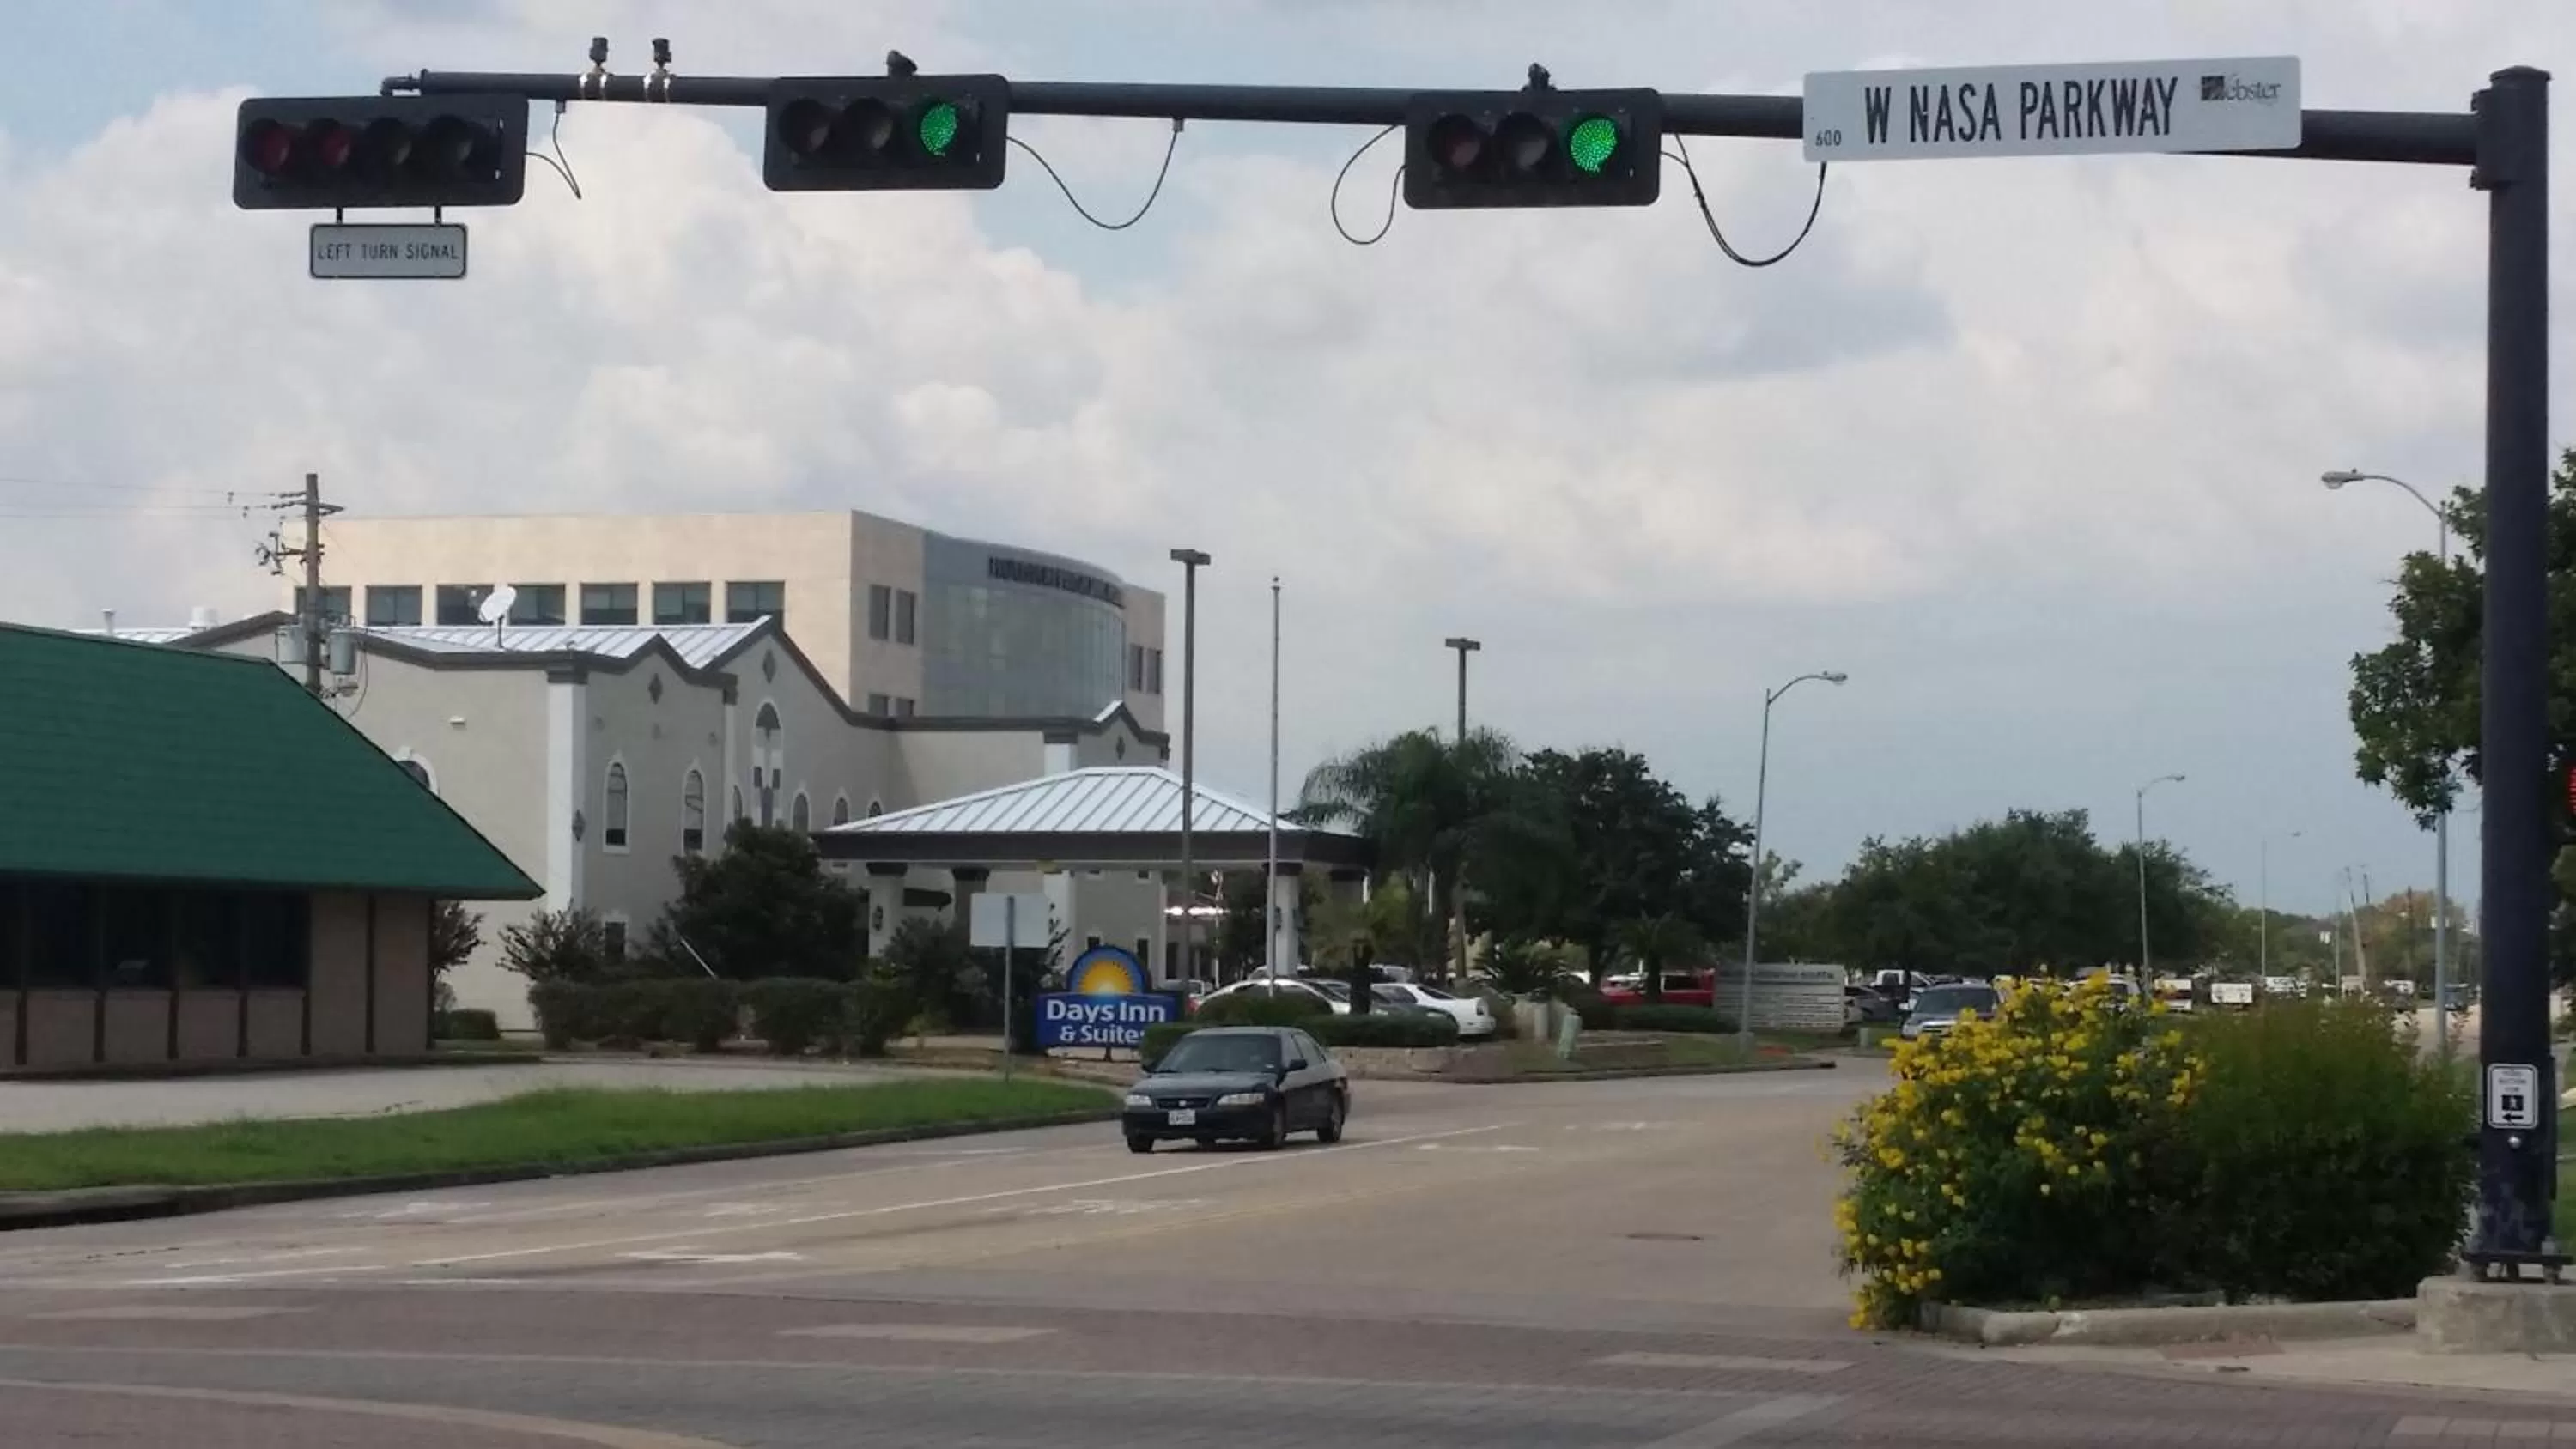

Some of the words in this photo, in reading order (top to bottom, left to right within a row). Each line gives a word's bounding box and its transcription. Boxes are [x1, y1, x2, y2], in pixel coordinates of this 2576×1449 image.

[1865, 86, 1891, 144] W
[1909, 82, 2002, 143] NASA
[2020, 76, 2178, 141] PARKWAY
[317, 243, 351, 260] LEFT
[361, 243, 399, 260] TURN
[405, 243, 459, 260] SIGNAL
[1047, 999, 1115, 1023] Days
[1119, 1001, 1165, 1022] Inn
[1060, 1025, 1075, 1042] &
[1080, 1024, 1145, 1044] Suite
